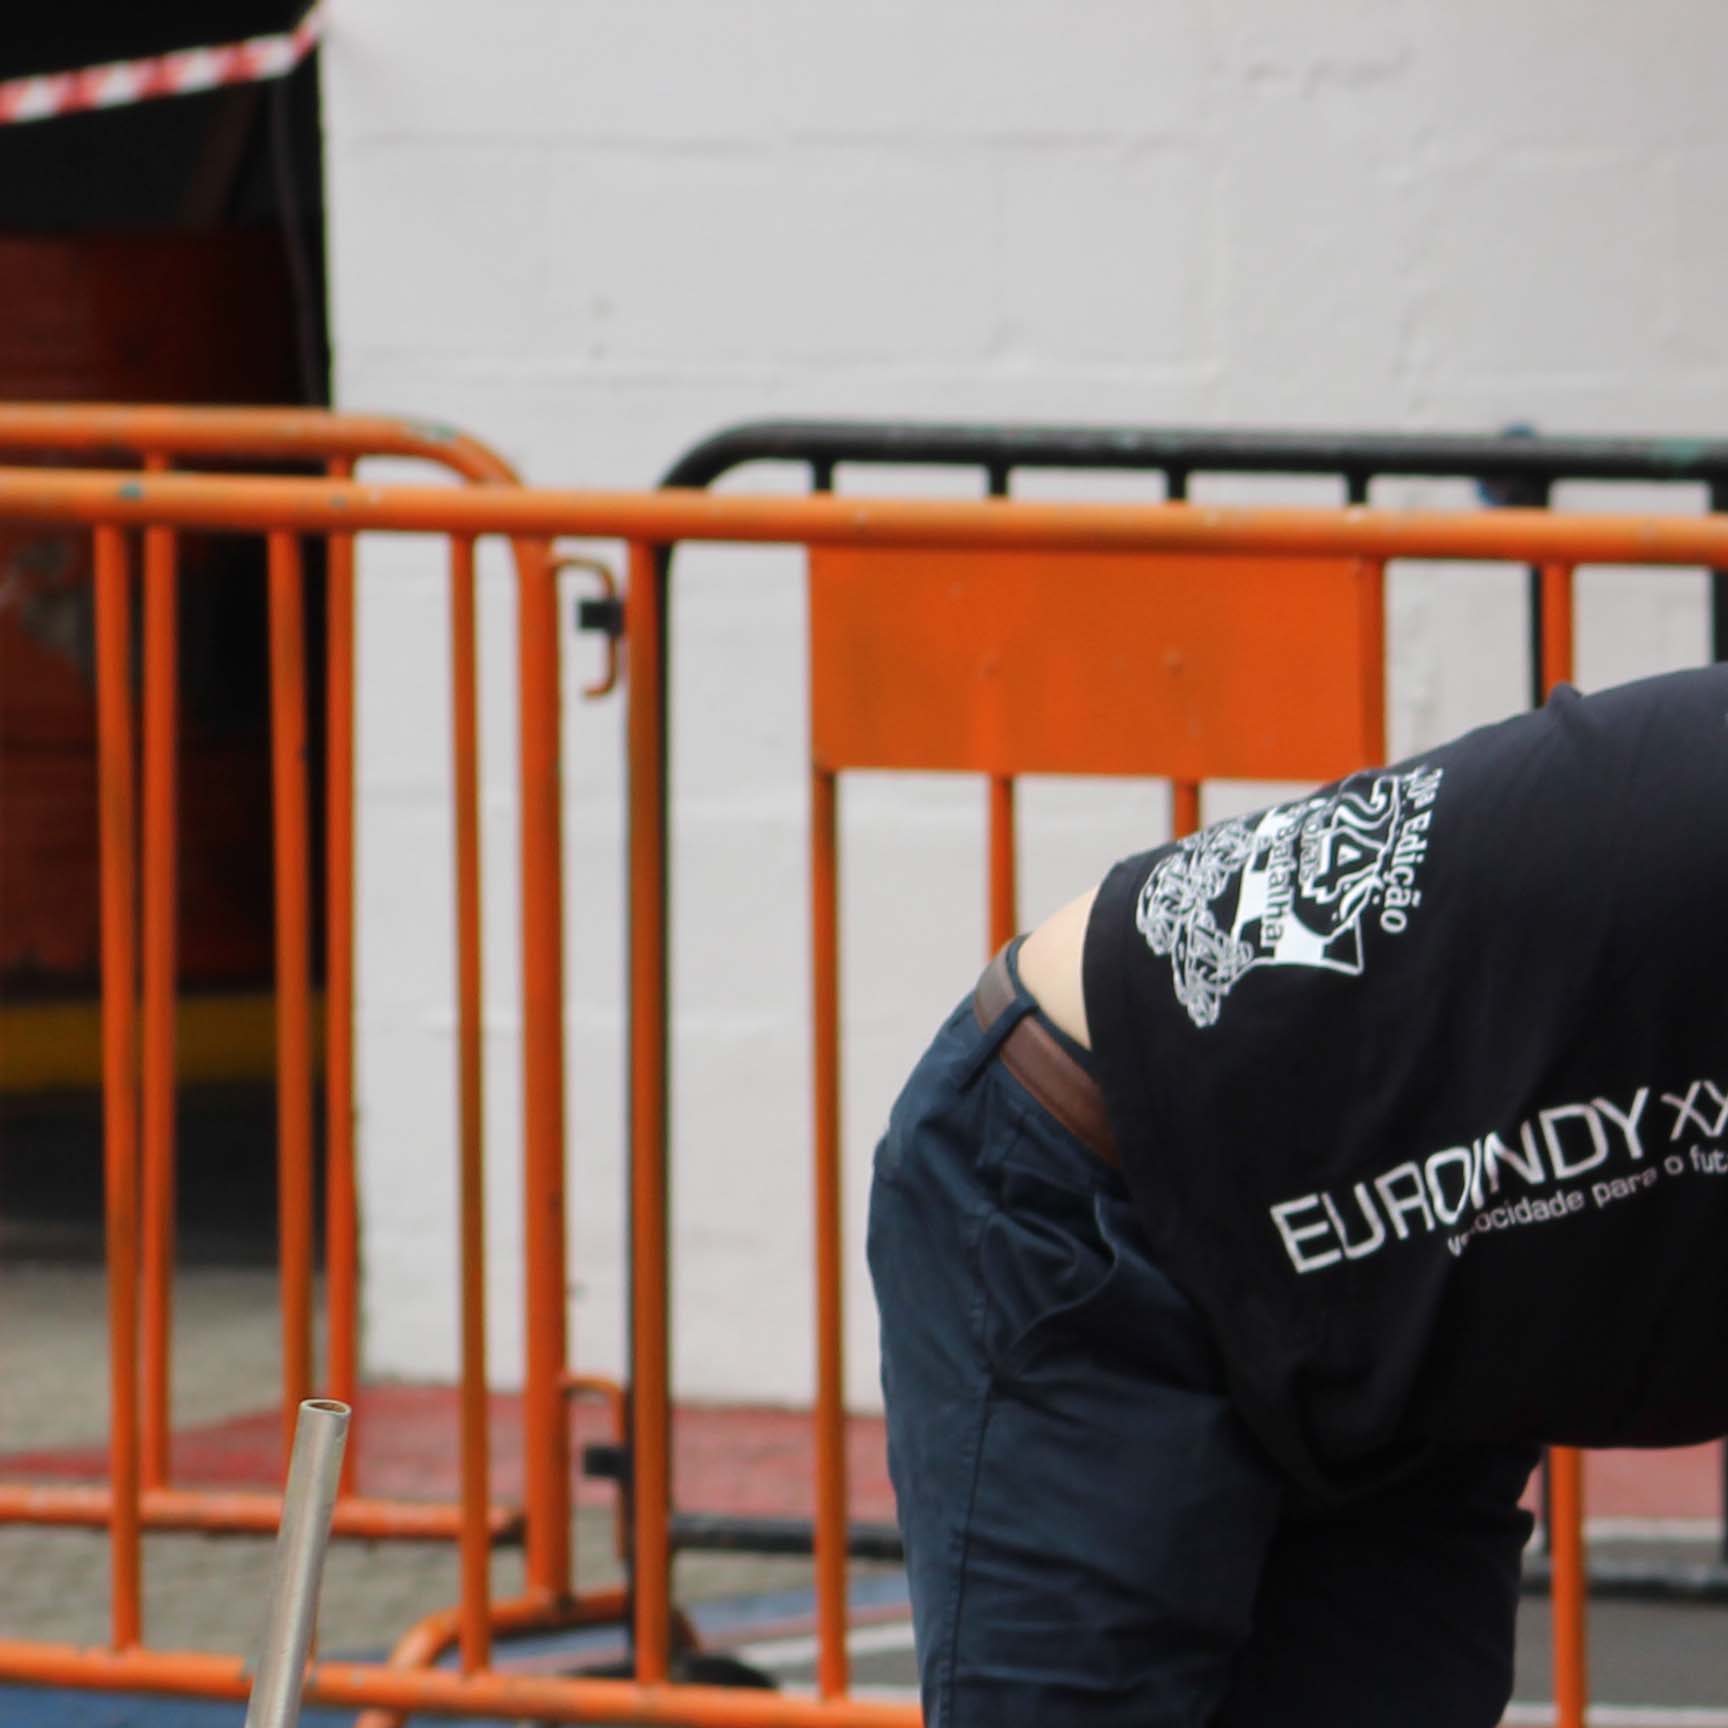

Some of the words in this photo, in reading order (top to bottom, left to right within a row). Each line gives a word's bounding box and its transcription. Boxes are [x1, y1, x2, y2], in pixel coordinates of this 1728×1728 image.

[1379, 810, 1433, 934] Edição
[1269, 1087, 1650, 1275] EUROINDY
[1446, 1189, 1585, 1257] veocidade
[1592, 1166, 1658, 1209] para
[1663, 1154, 1685, 1176] o
